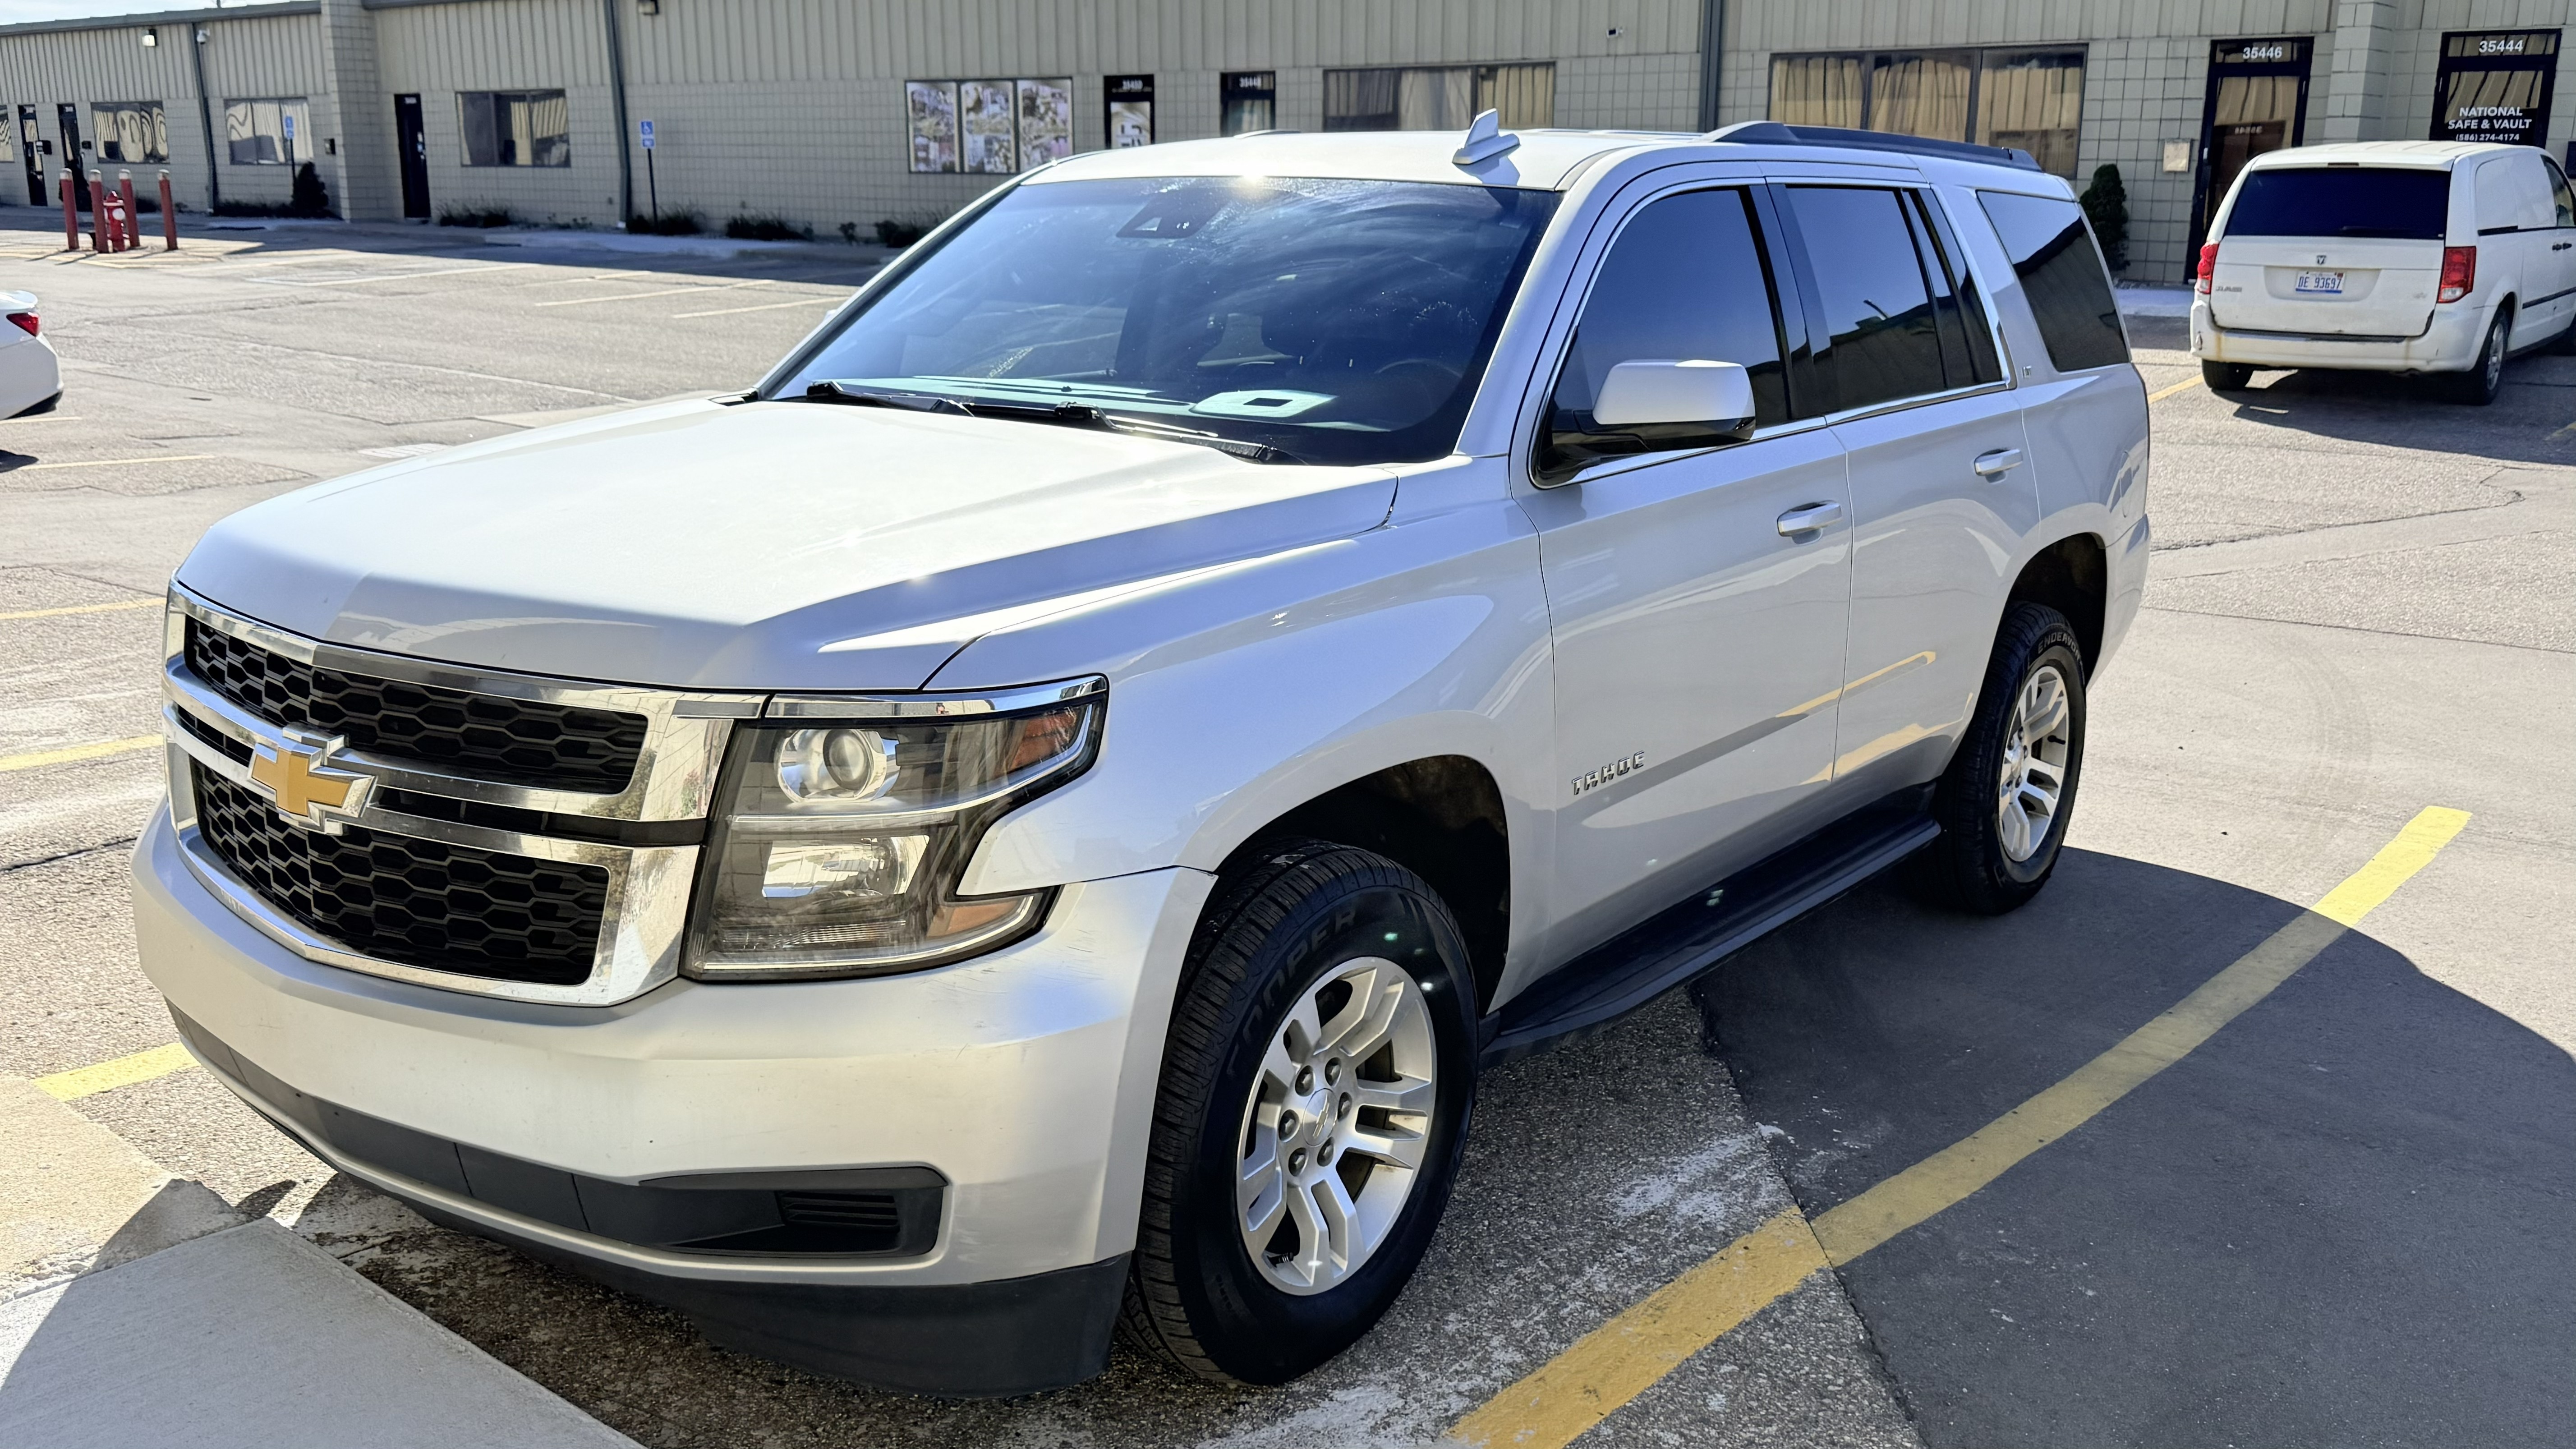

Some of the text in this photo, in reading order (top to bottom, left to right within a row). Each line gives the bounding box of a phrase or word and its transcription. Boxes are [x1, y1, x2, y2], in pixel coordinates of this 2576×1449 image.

[2243, 46, 2282, 60] 35446
[2479, 40, 2524, 53] 35444
[2459, 106, 2523, 117] NATIONAL
[2448, 119, 2532, 129] SAFE & VAULT
[2456, 133, 2478, 142] (586)
[2298, 276, 2342, 290] DE 93697
[1571, 750, 1645, 796] TAHOE
